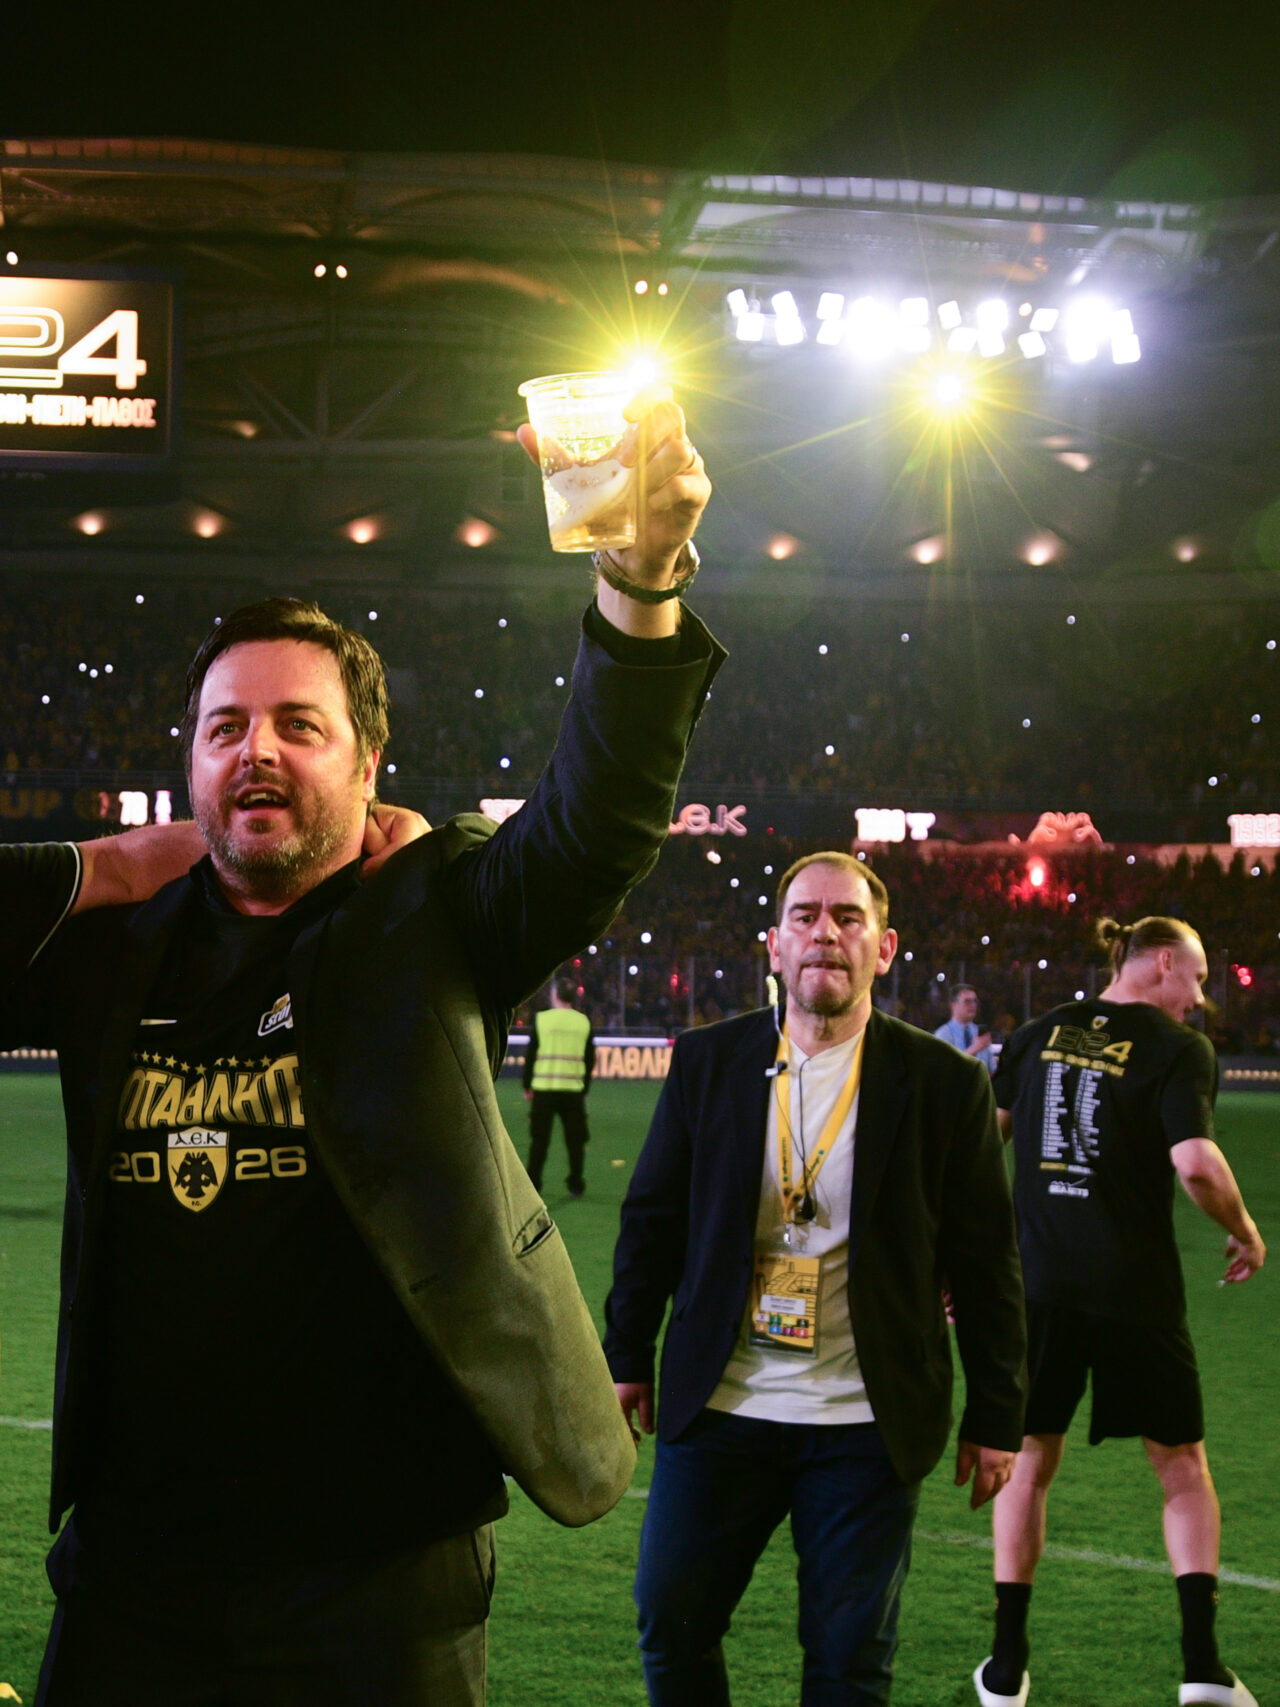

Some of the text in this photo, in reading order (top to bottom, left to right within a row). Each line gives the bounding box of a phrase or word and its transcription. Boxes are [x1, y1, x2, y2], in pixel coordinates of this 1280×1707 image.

[592, 1046, 673, 1079] ΤΑΘΛΗ
[110, 1145, 307, 1183] 20 26
